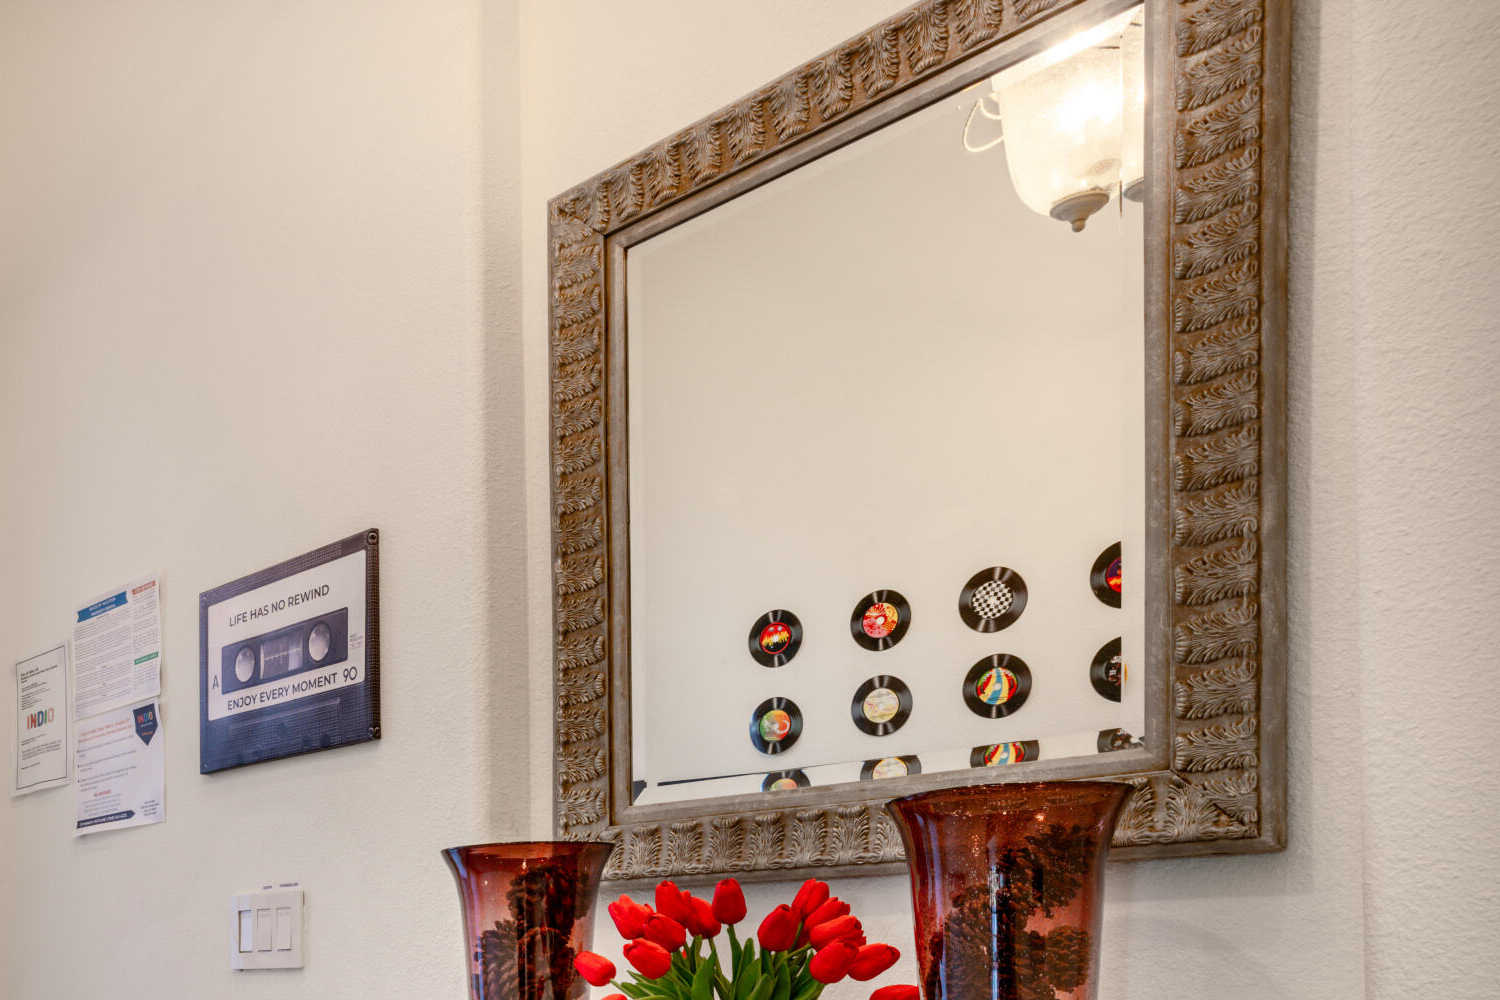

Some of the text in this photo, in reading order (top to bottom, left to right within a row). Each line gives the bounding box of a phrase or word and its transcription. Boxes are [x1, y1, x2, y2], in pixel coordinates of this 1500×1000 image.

[229, 584, 330, 627] LIFE HAS NO REWIND
[212, 675, 219, 690] A
[227, 666, 358, 711] ENJOY EVERY MOMENT 90
[26, 707, 55, 729] INDIO
